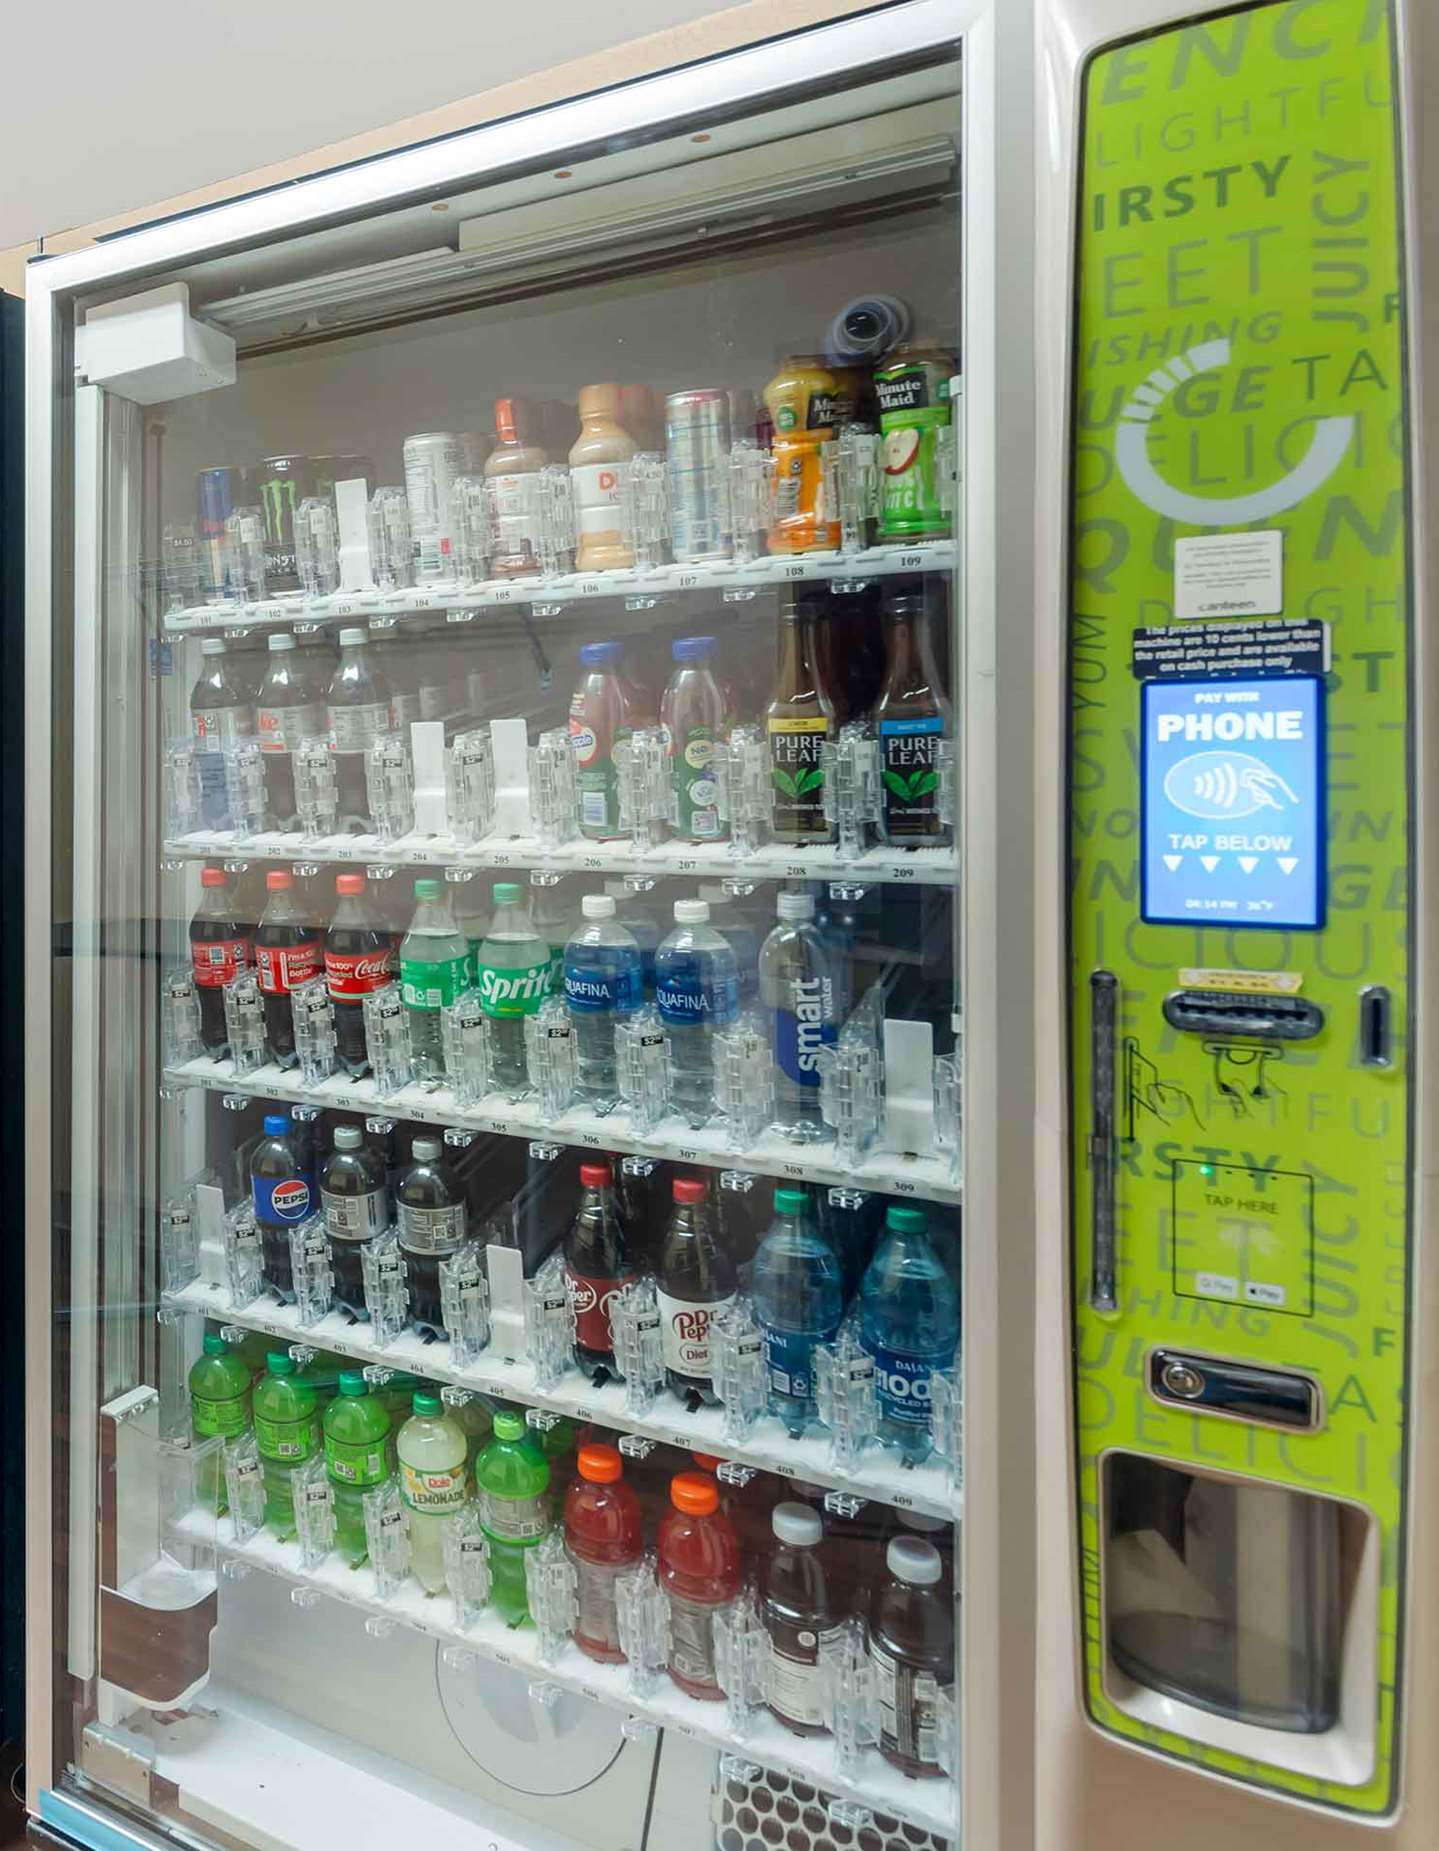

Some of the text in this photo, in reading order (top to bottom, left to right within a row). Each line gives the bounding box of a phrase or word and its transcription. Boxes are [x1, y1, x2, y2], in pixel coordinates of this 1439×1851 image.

[1312, 149, 1370, 333] JUICY
[879, 393, 915, 409] Maid
[900, 555, 922, 567] 109
[785, 566, 805, 577] 108
[679, 576, 698, 587] 107
[582, 583, 599, 594] 106
[495, 590, 511, 600] 105
[1197, 600, 1257, 612] canteen
[1134, 629, 1322, 648] machine are 10 cents lower than
[1135, 642, 1321, 660] the retail price and are available
[1159, 656, 1293, 672] on cash purchase only
[1195, 691, 1260, 704] PAY WITH
[1157, 710, 1304, 741] PHONE
[775, 736, 825, 749] PURE
[888, 737, 938, 750] PURE
[775, 750, 822, 763] LEAF
[1168, 834, 1293, 851] TAP BELOW
[494, 855, 510, 865] 205
[584, 858, 602, 868] 206
[678, 860, 697, 870] 207
[786, 866, 807, 877] 208
[892, 868, 915, 879] 209
[822, 975, 833, 1019] water
[790, 977, 822, 1072] smart
[491, 1121, 507, 1132] 305
[581, 1134, 600, 1146] 306
[678, 1149, 698, 1161] 307
[783, 1164, 804, 1176] 308
[893, 1181, 916, 1194] 309
[274, 1192, 310, 1206] PEPSI
[1204, 1193, 1280, 1216] TAP HERE
[686, 1350, 708, 1361] Diet
[489, 1385, 505, 1397] 405
[576, 1408, 594, 1420] 406
[672, 1435, 692, 1447] 407
[775, 1463, 796, 1477] 408
[413, 1489, 464, 1505] LEMONADE
[890, 1494, 914, 1508] 409
